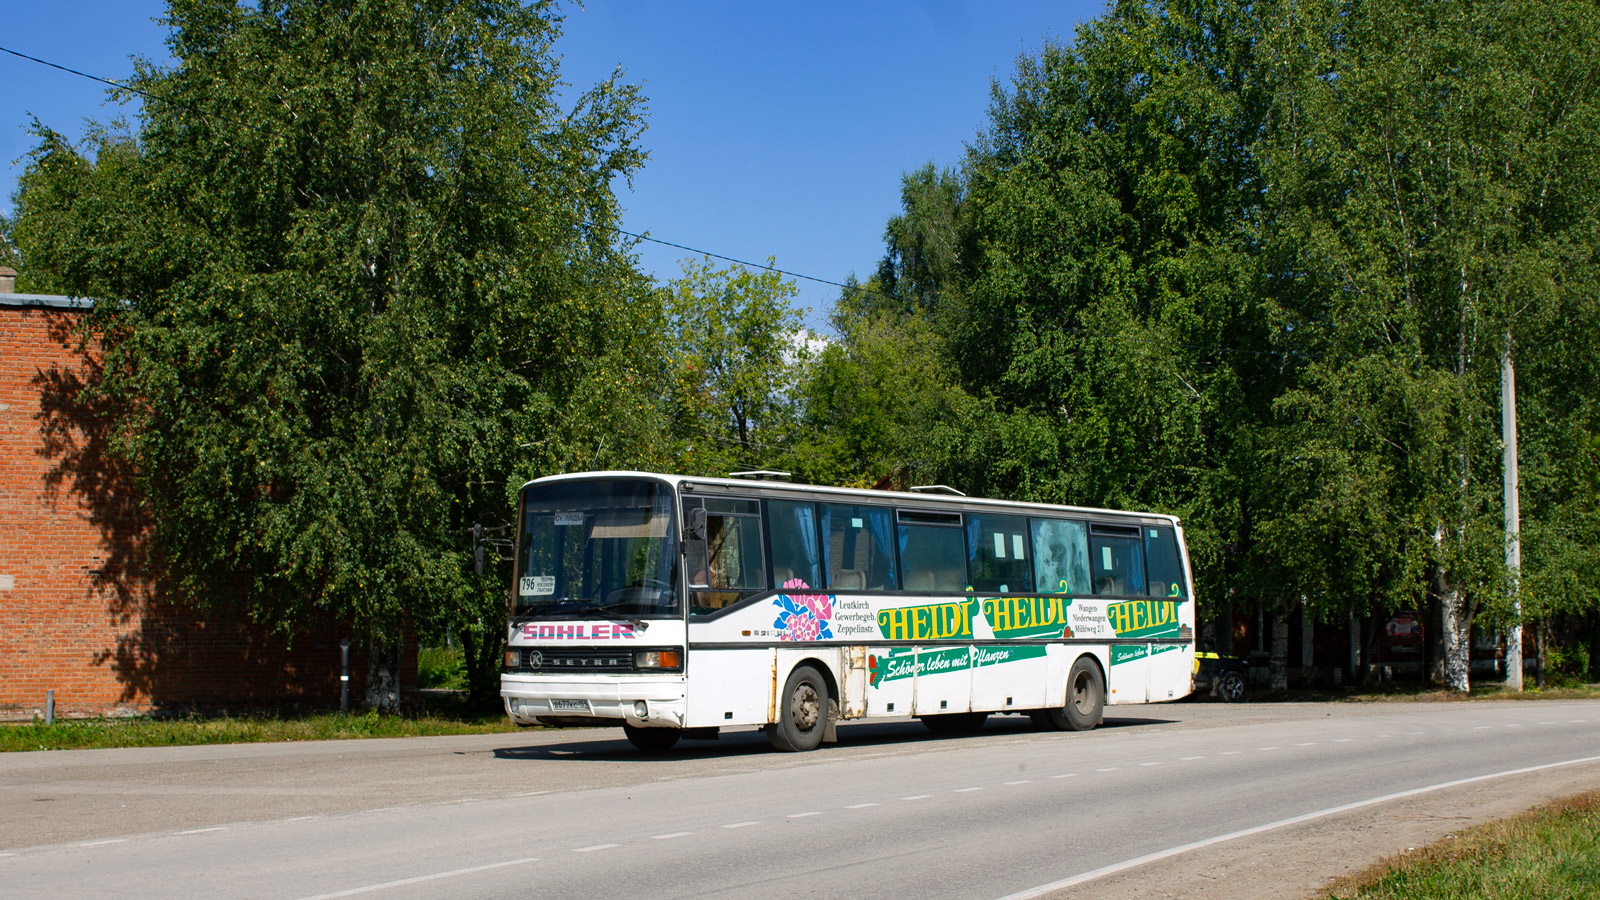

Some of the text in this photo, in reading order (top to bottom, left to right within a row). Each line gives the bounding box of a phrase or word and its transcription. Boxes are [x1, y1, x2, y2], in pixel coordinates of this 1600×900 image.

[521, 577, 535, 591] 796
[839, 600, 870, 610] Leutkirch
[983, 580, 1067, 632] HEIDI
[1107, 583, 1179, 634] HEIDI
[834, 612, 877, 624] Gewerbegeb.
[878, 587, 974, 640] HEIDI
[523, 624, 636, 640] SOHLER
[837, 623, 874, 634] Zeppelinstr.
[552, 658, 619, 666] SETRA
[886, 647, 1010, 678] Schöner leben mit Pflanzen
